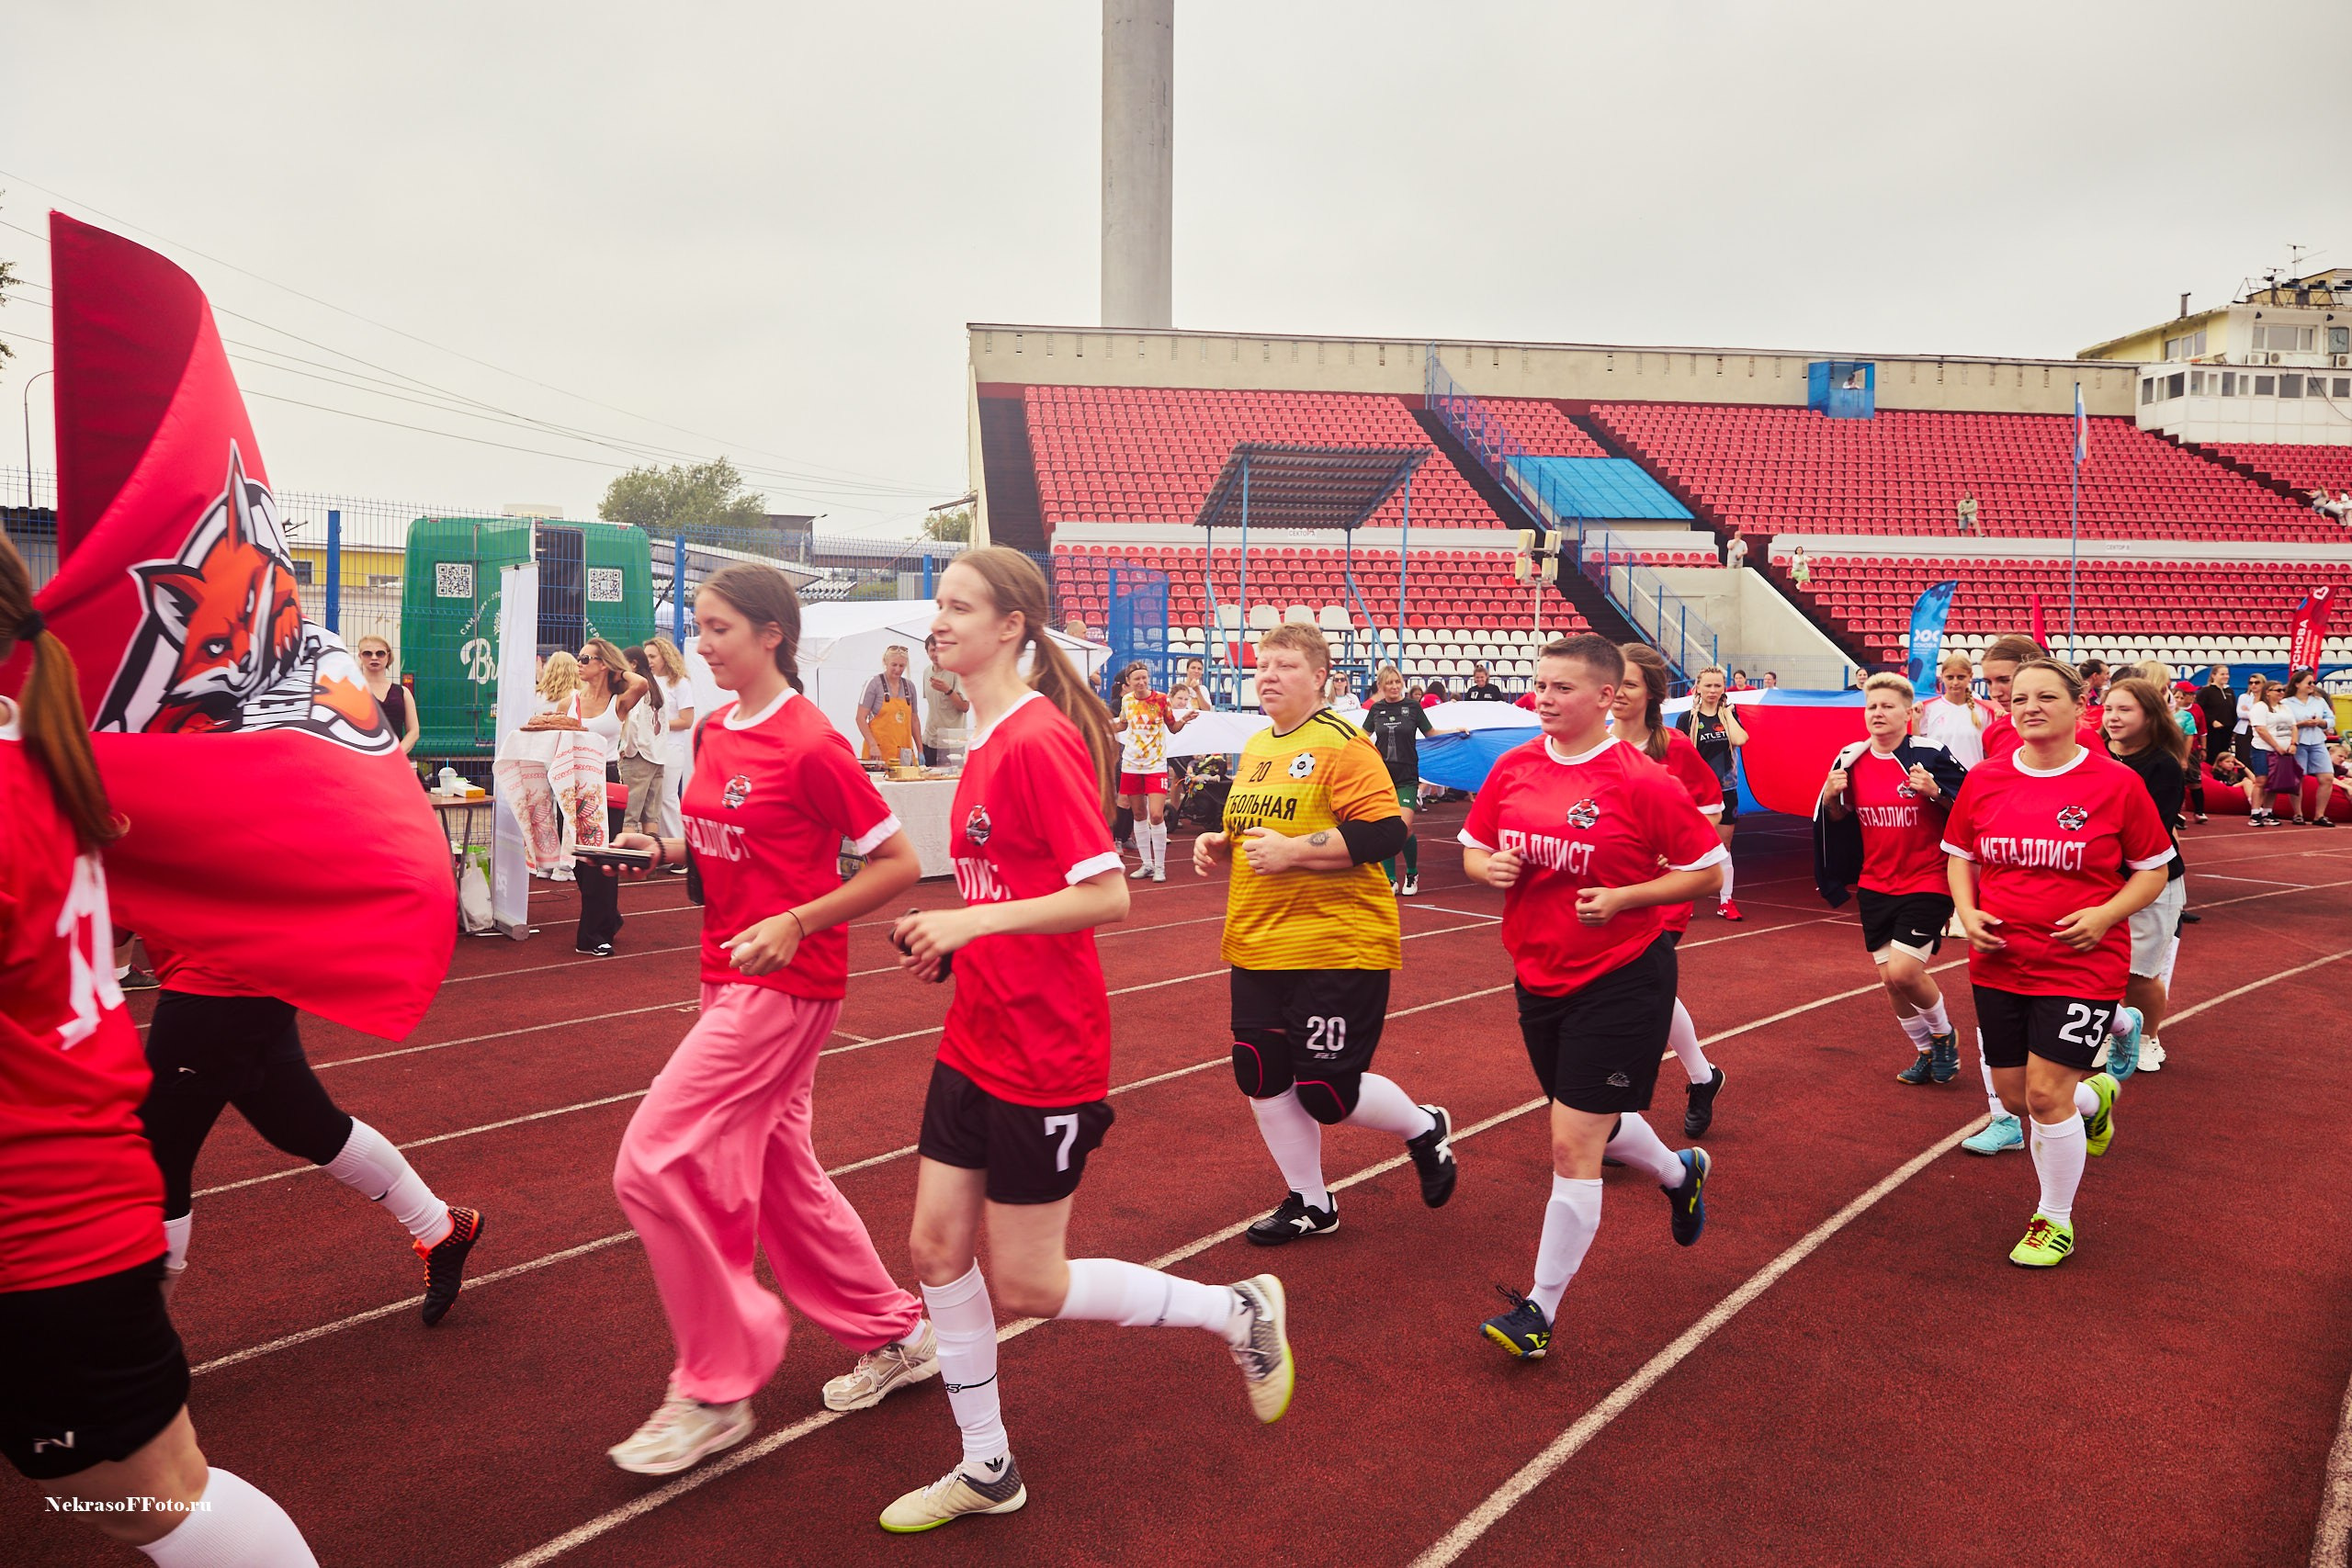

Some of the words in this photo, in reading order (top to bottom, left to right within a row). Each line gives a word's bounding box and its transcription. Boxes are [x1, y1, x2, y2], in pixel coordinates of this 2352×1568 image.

[1249, 761, 1272, 783] 20
[1306, 1015, 1346, 1052] 20
[2058, 1002, 2110, 1047] 23
[1044, 1112, 1079, 1173] 7
